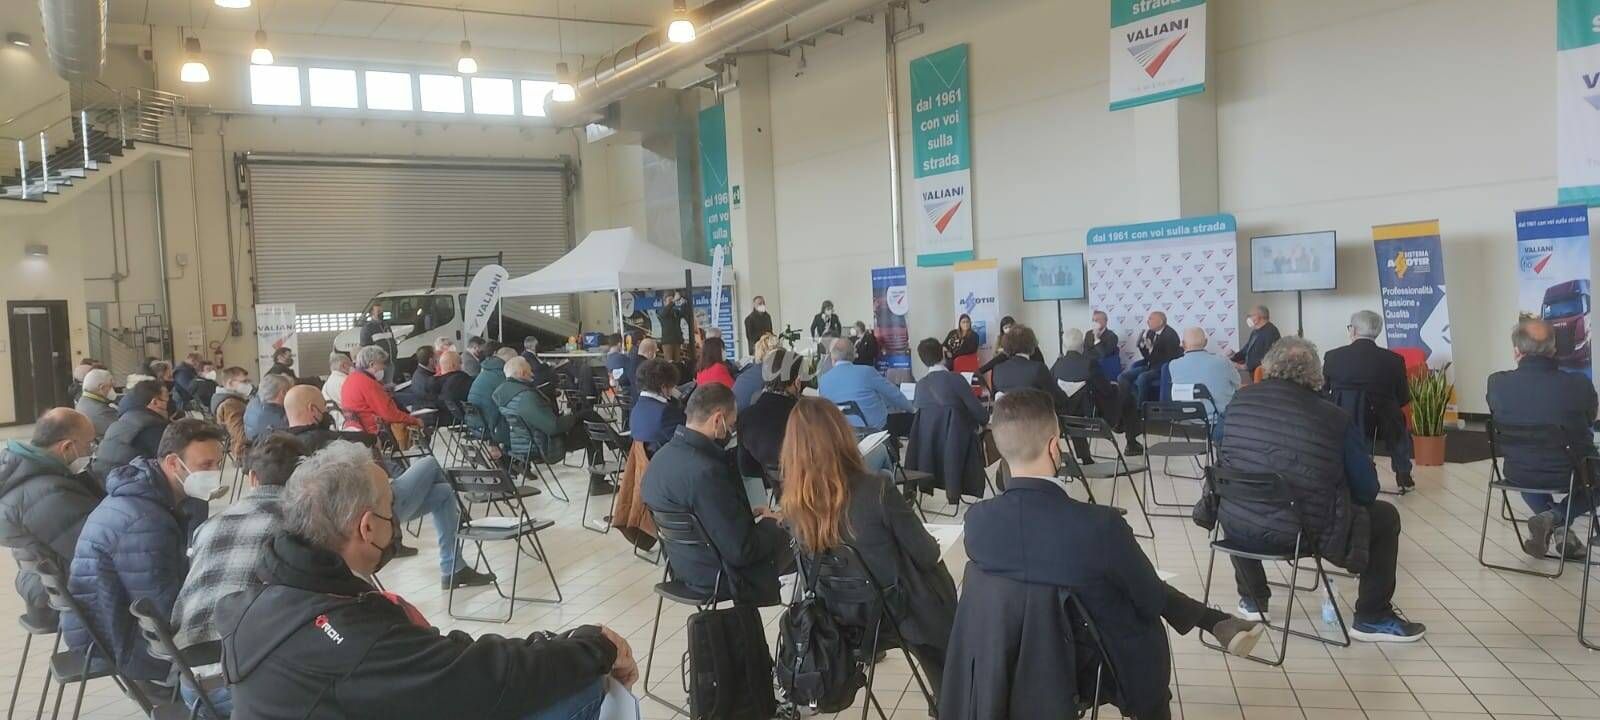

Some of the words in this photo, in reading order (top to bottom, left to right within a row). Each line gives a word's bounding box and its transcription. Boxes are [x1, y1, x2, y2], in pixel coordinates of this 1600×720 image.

[1126, 17, 1189, 43] VALIANI
[916, 96, 932, 112] dal
[935, 88, 961, 107] 1961
[920, 117, 940, 131] con
[943, 109, 960, 126] voi
[927, 134, 953, 150] sulla
[923, 153, 960, 171] strada
[922, 184, 964, 200] VALIANI
[1092, 233, 1106, 242] dal
[1108, 231, 1128, 241] 1961
[1131, 231, 1148, 239] con
[1150, 229, 1164, 237] voi
[1167, 225, 1190, 235] sulla
[1193, 221, 1226, 233] strada
[476, 274, 502, 318] VALIANI
[1384, 299, 1415, 308] Passione
